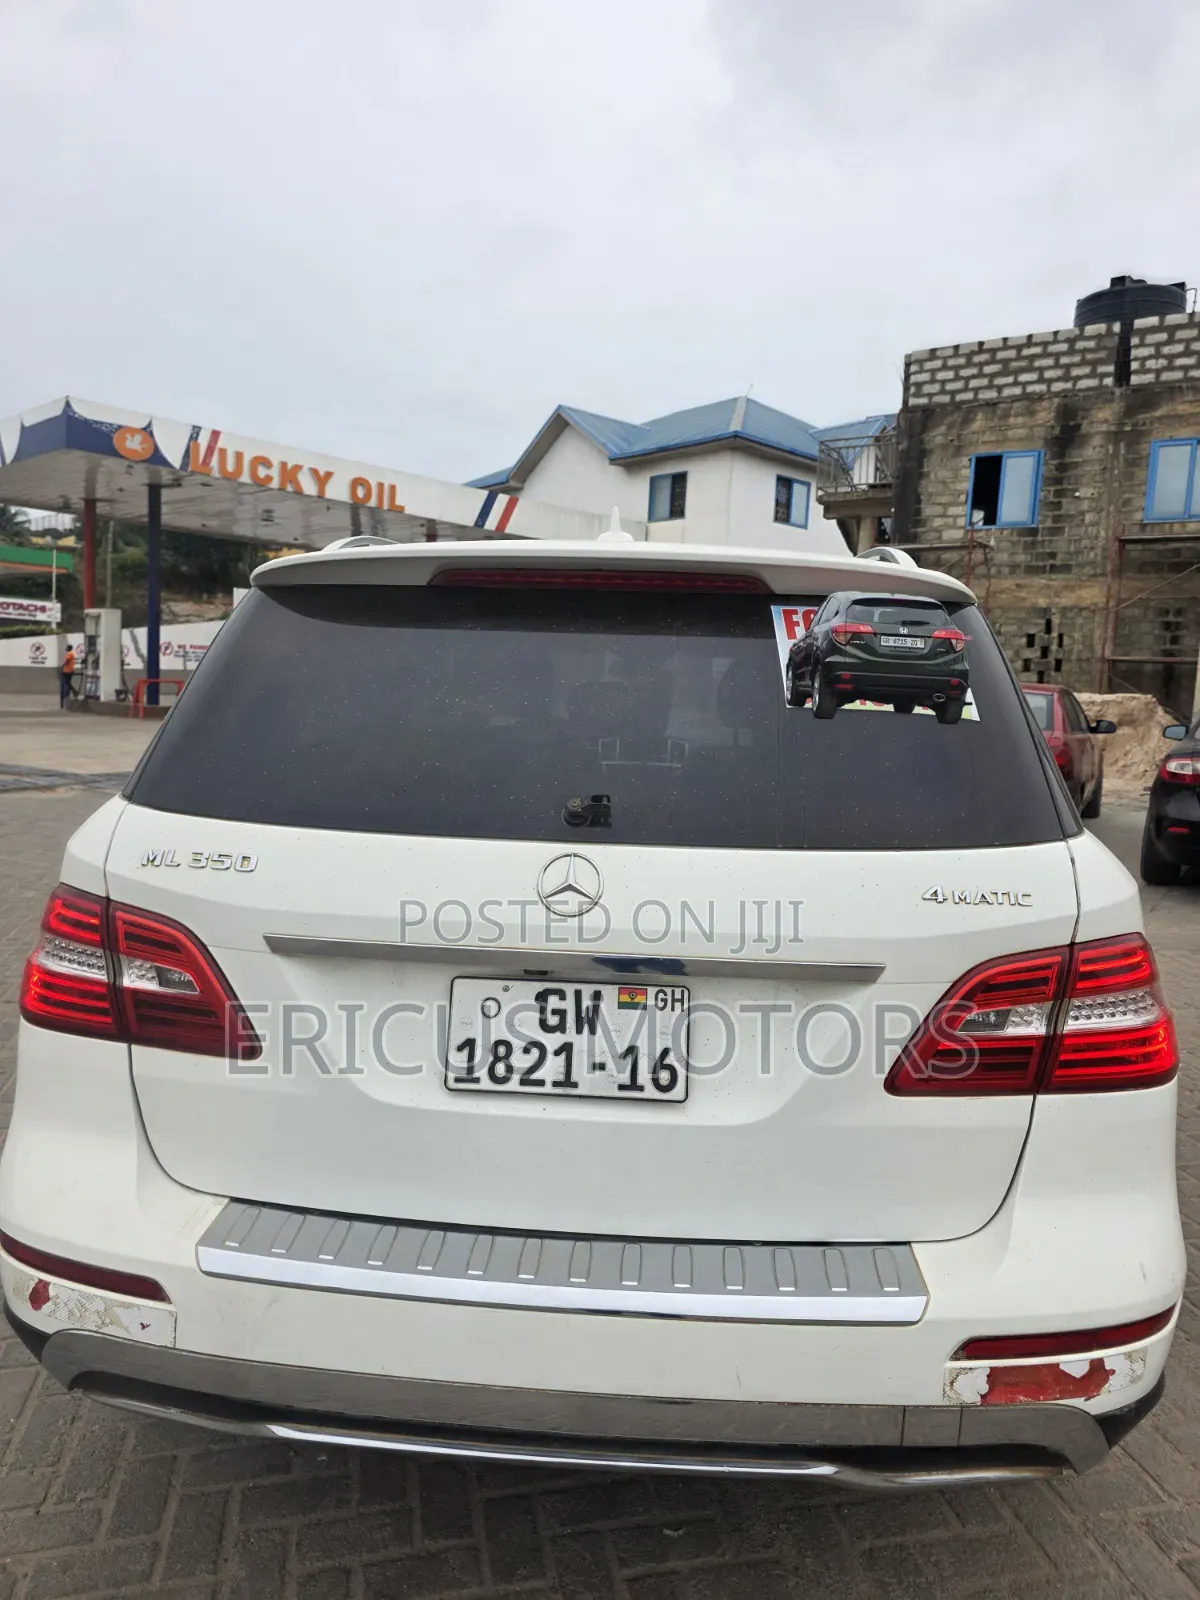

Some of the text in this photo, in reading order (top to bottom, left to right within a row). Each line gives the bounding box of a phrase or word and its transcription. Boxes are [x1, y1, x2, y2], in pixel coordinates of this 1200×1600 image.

[189, 441, 405, 513] LUCKY OIL
[141, 848, 258, 873] ML 350
[537, 987, 685, 1036] GW GH
[453, 1037, 679, 1094] 1821-16
